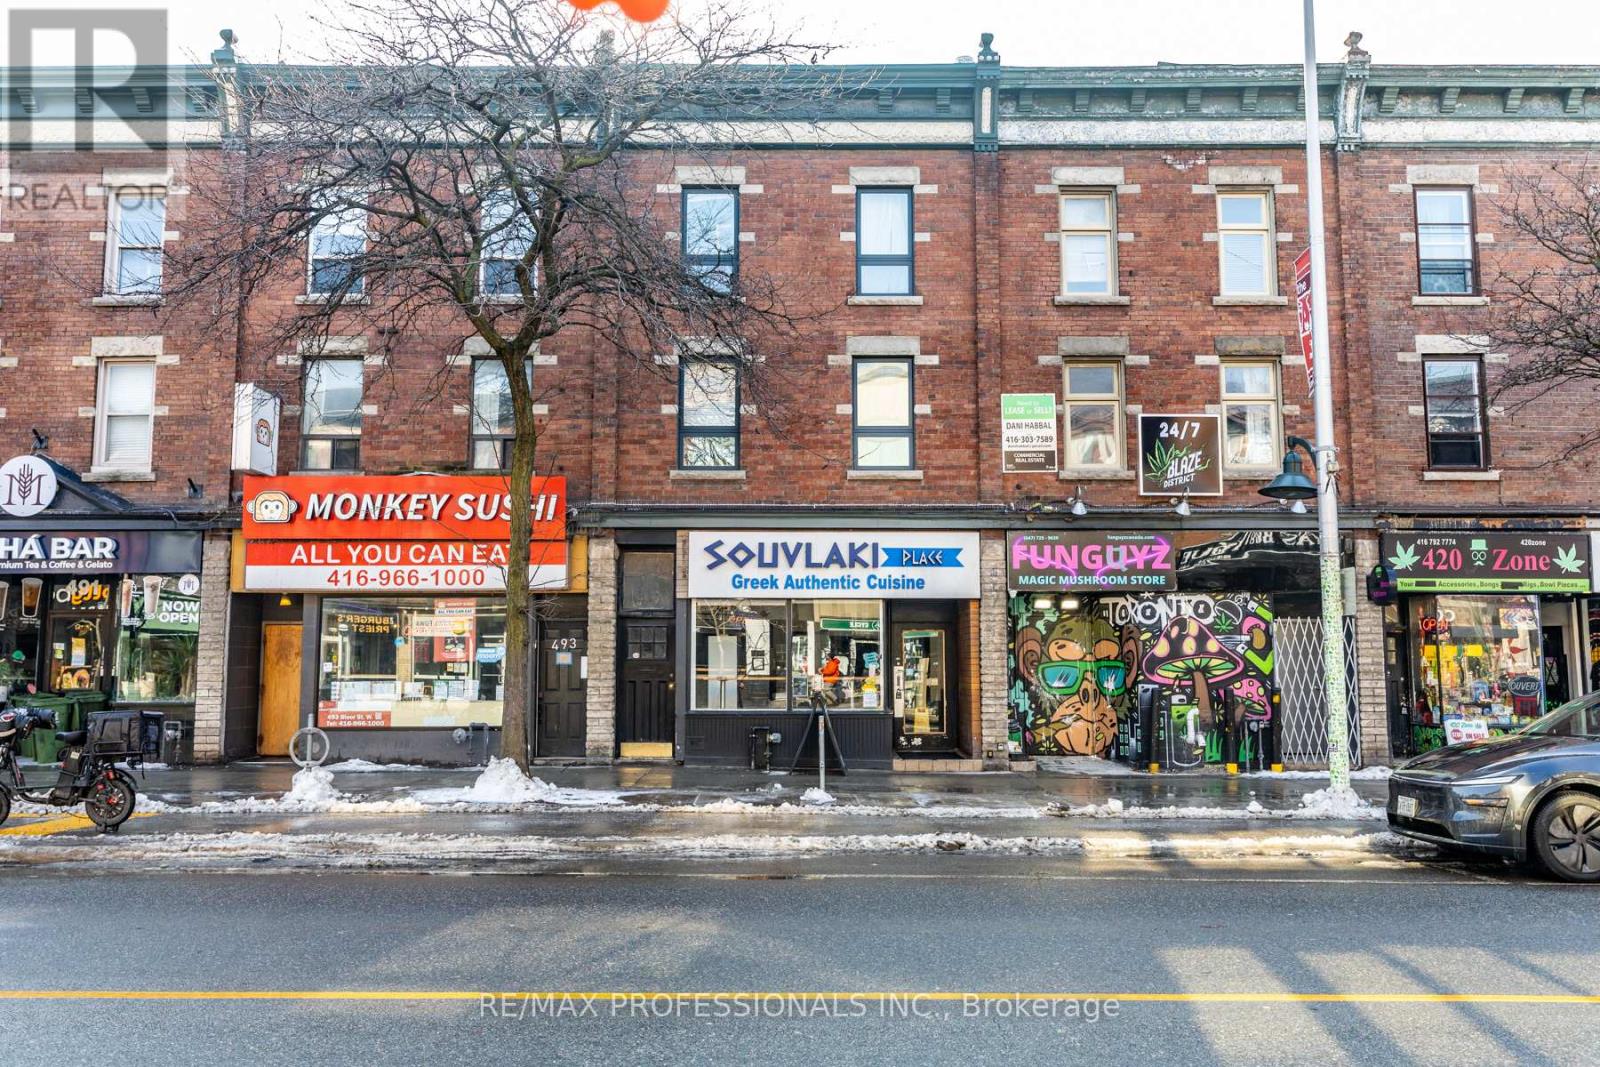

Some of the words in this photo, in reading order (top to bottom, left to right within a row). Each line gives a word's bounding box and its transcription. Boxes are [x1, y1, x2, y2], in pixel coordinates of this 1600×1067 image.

[1006, 422, 1024, 430] DANI
[1024, 422, 1053, 430] HABBAL
[1160, 421, 1200, 440] 24/7
[1005, 435, 1054, 443] 416-303-7589
[1167, 450, 1202, 479] BLAZE
[1163, 473, 1195, 488] DISTRICT
[305, 493, 450, 520] MONKEY
[50, 537, 116, 559] BAR
[290, 544, 340, 564] ALL
[347, 544, 401, 564] YOU
[409, 544, 464, 564] CAN
[472, 544, 511, 564] EA
[703, 539, 879, 570] SOUVLAKI
[902, 549, 943, 566] PLACE
[24, 560, 40, 568] Tea
[41, 560, 48, 568] &
[48, 560, 77, 568] Coffee
[77, 560, 84, 568] &
[85, 560, 113, 568] Gelato
[1422, 547, 1463, 571] 420
[1491, 547, 1551, 571] Zone
[327, 569, 485, 587] 416-966-1000
[731, 574, 779, 590] Greek
[784, 574, 861, 590] Authentic
[866, 574, 925, 590] Cuisine
[1018, 575, 1056, 585] MAGIC
[1059, 575, 1128, 585] MUSHROOM
[1131, 575, 1166, 585] STORE
[162, 601, 200, 612] NOW
[1099, 594, 1216, 631] TORONTO
[160, 612, 198, 624] OPEN
[1422, 618, 1448, 630] OPN
[552, 638, 576, 650] 493
[1510, 682, 1538, 690] OUVERT
